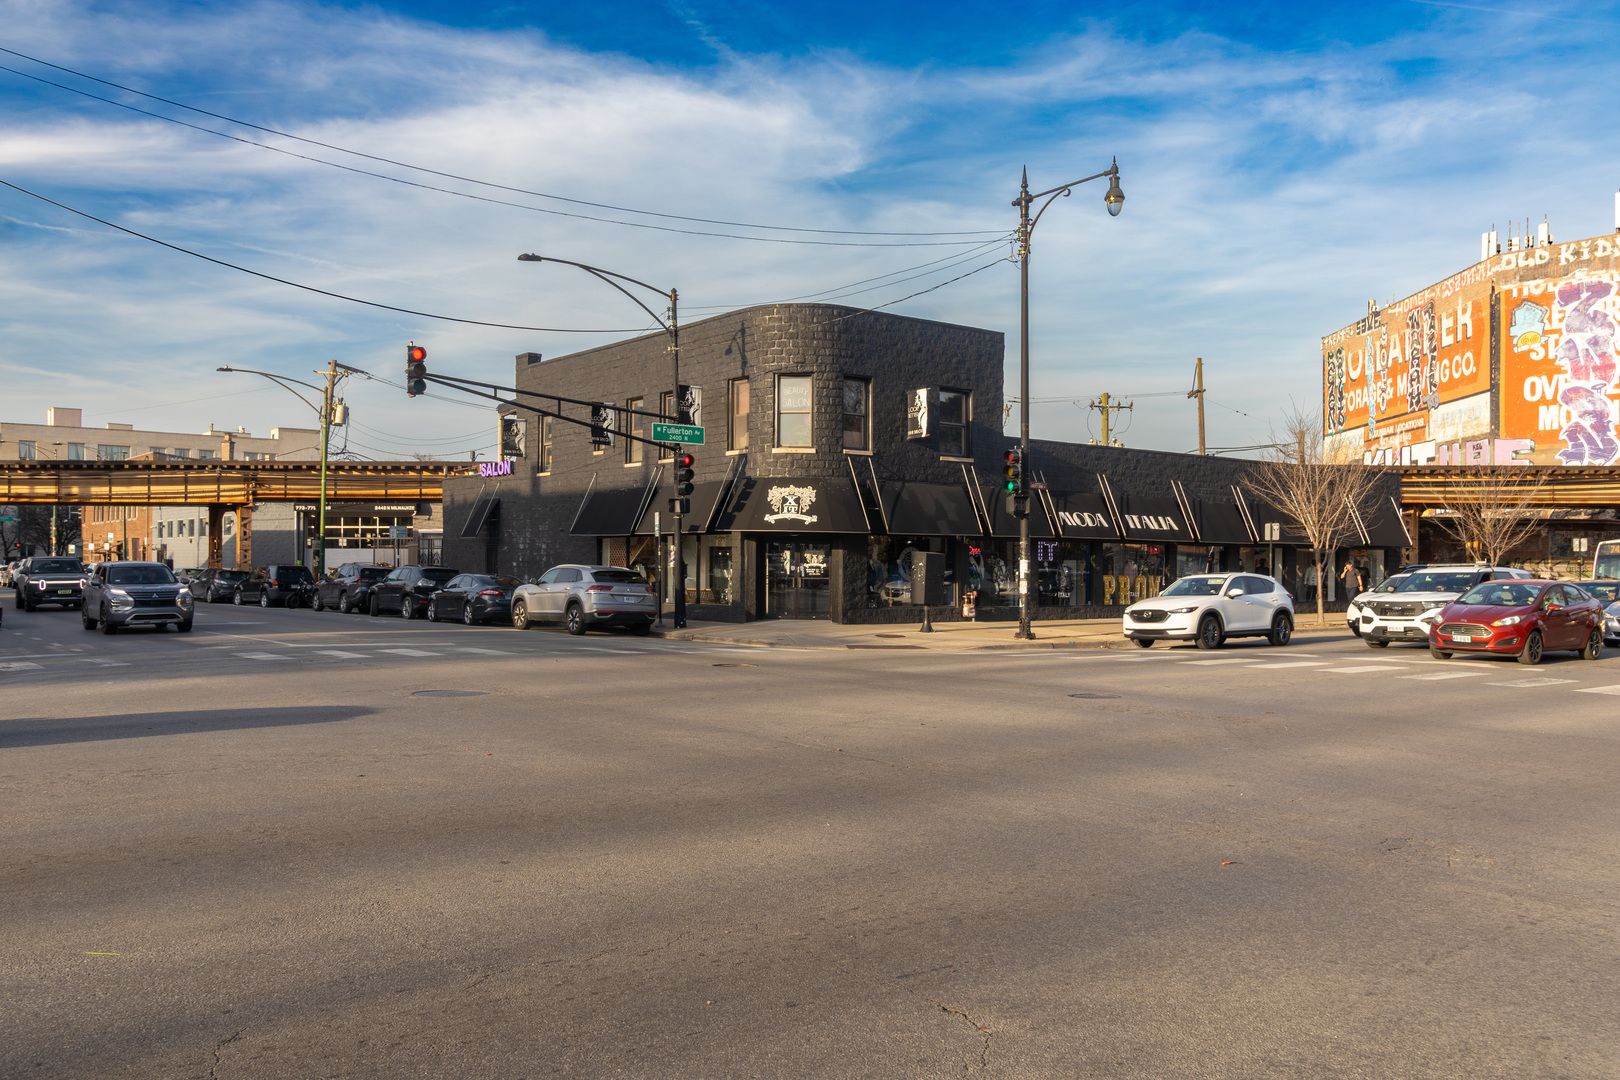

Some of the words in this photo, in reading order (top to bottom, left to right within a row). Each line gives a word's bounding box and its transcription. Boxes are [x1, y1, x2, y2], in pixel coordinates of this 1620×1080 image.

[1451, 351, 1477, 379] CO.
[662, 427, 693, 436] Fullerton
[480, 460, 512, 477] SALON
[1058, 511, 1109, 528] MODA
[1125, 514, 1179, 531] ITALIA
[1038, 541, 1058, 561] IT
[1103, 575, 1161, 605] PROM
